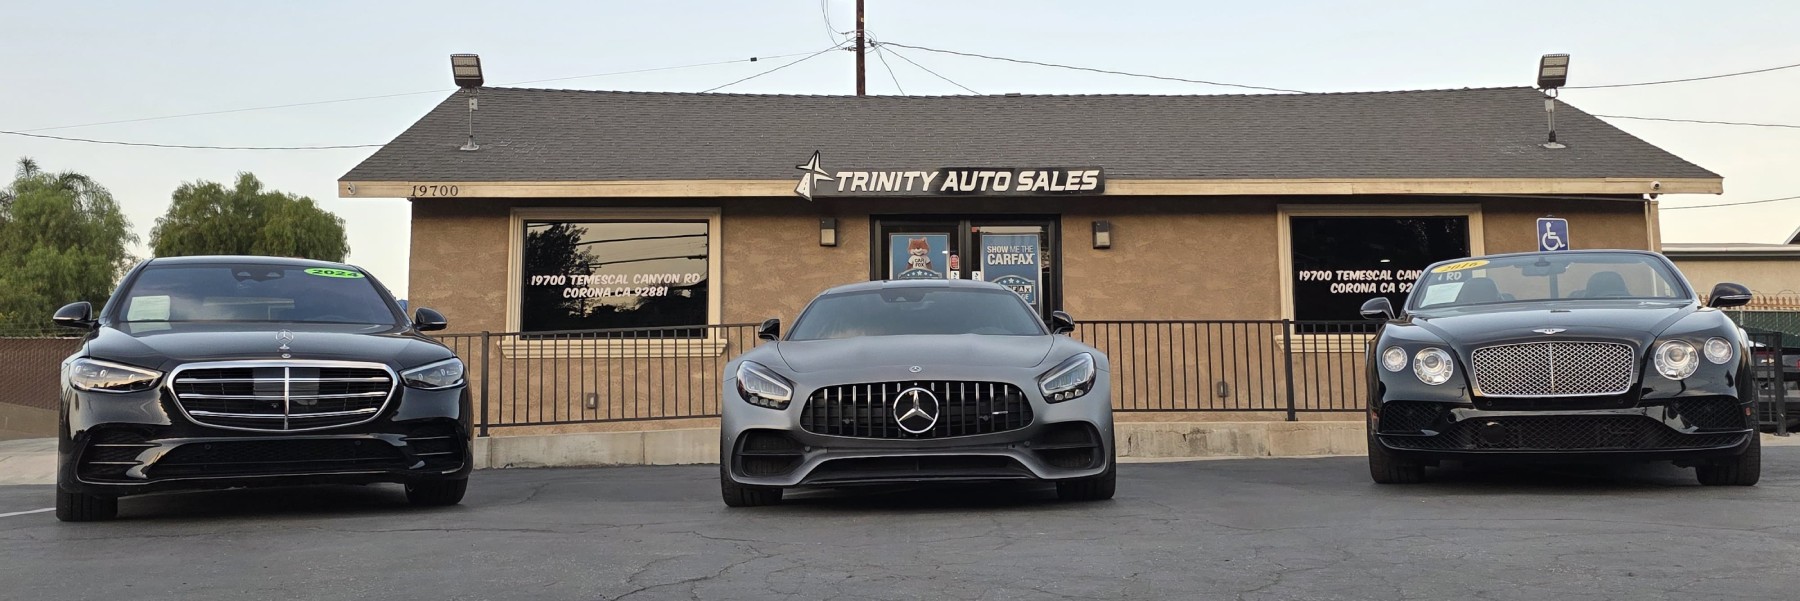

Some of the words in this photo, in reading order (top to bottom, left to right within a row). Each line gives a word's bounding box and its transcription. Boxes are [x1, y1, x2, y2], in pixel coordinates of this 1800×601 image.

[836, 171, 939, 192] TRINITY
[941, 171, 1012, 192] AUTO
[1016, 169, 1100, 191] SALES
[410, 184, 459, 197] 19700
[987, 245, 1008, 253] SHOW
[1010, 245, 1020, 253] ME
[1021, 245, 1034, 253] THE
[987, 253, 1035, 265] CARFAX
[311, 268, 359, 278] 2024
[1299, 270, 1333, 281] 19700
[1336, 270, 1393, 281] TEMESCAL
[1396, 269, 1424, 281] CAN
[1446, 271, 1462, 281] RD
[531, 275, 566, 286] 19700
[570, 274, 629, 286] TEMESCAL
[633, 273, 681, 285] CANYON
[683, 273, 701, 284] RD
[563, 287, 612, 299] CORONA
[615, 287, 632, 298] CA
[634, 286, 668, 297] 92881
[1330, 283, 1377, 294] CORONA
[1380, 282, 1396, 293] CA
